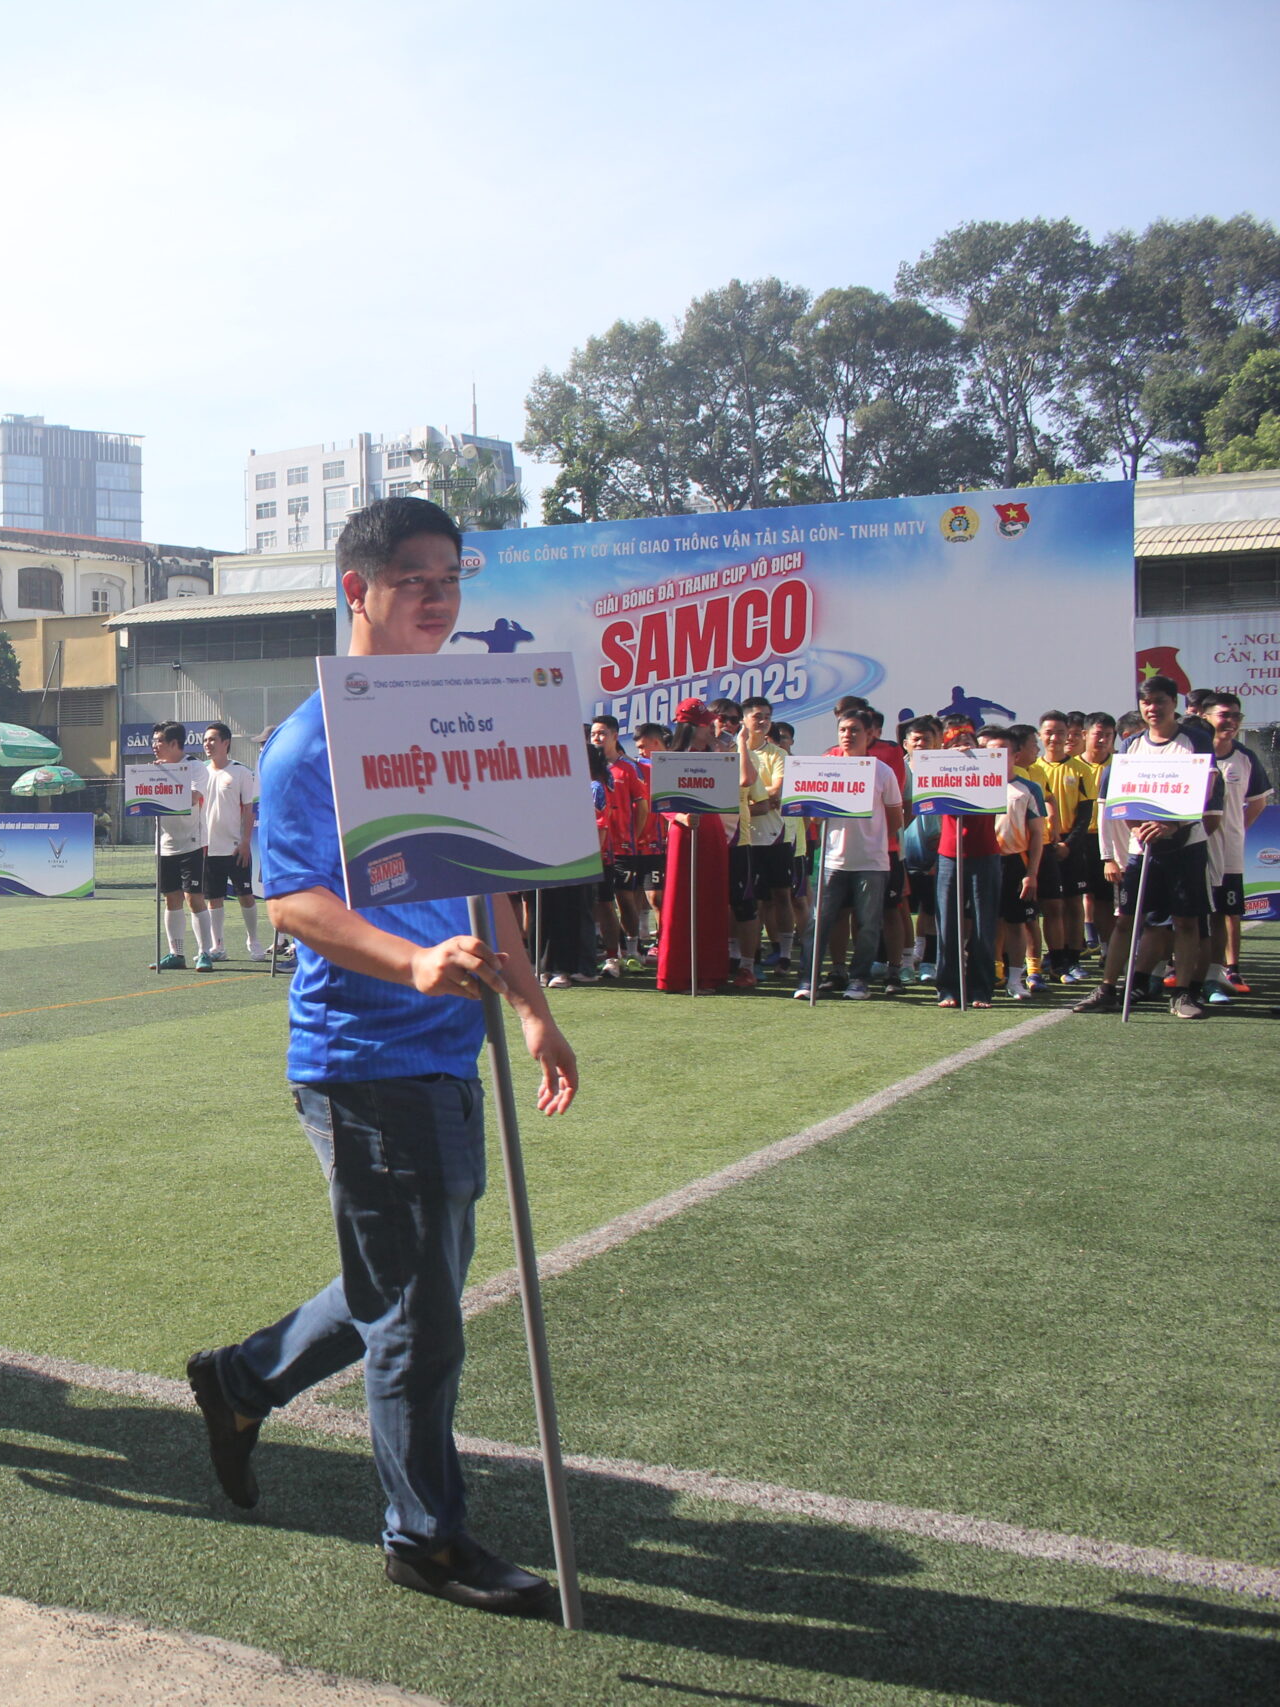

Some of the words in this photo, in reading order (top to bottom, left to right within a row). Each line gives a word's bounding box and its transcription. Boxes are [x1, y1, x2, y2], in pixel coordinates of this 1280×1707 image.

[498, 545, 531, 564] TỔNG
[534, 544, 568, 562] CÔNG
[572, 545, 587, 559] TY
[613, 537, 635, 556] KHÍ
[639, 539, 670, 554] GIAO
[674, 532, 719, 552] THÔNG
[723, 529, 751, 551] VẬN
[754, 527, 777, 546] TẢI
[781, 525, 804, 544] SÀI
[850, 521, 889, 540] TNHH
[894, 520, 927, 537] MTV
[595, 593, 619, 617] GIẢI
[622, 585, 655, 610] BÓNG
[658, 580, 675, 601] ĐÁ
[678, 571, 719, 595] TRANH
[722, 565, 748, 586] CUP
[750, 557, 768, 579] VÔ
[771, 551, 802, 575] ĐỊCH
[599, 577, 812, 695] SAMCO
[720, 657, 808, 704] 2025
[430, 717, 457, 738] Cục
[458, 712, 476, 733] hồ
[478, 716, 494, 732] sơ
[127, 731, 149, 747] SÂN
[361, 744, 438, 794] NGHIỆP
[442, 750, 471, 791] VỤ
[474, 740, 522, 783] PHÍA
[525, 744, 572, 778] NAM
[677, 776, 715, 789] ISAMCO
[794, 780, 829, 793] SAMCO
[831, 781, 844, 793] AN
[847, 781, 865, 795] LẠC
[917, 776, 929, 788] XE
[931, 773, 962, 787] KHÁCH
[965, 772, 980, 787] SÀI
[983, 772, 1002, 787] GÒN
[135, 783, 152, 796] TỔNG
[155, 782, 173, 795] CÔNG
[175, 784, 184, 795] TY
[1184, 785, 1190, 794] 2
[369, 857, 406, 885] SAMCO
[623, 871, 631, 883] 7
[651, 871, 660, 883] 5
[1227, 891, 1236, 906] 8
